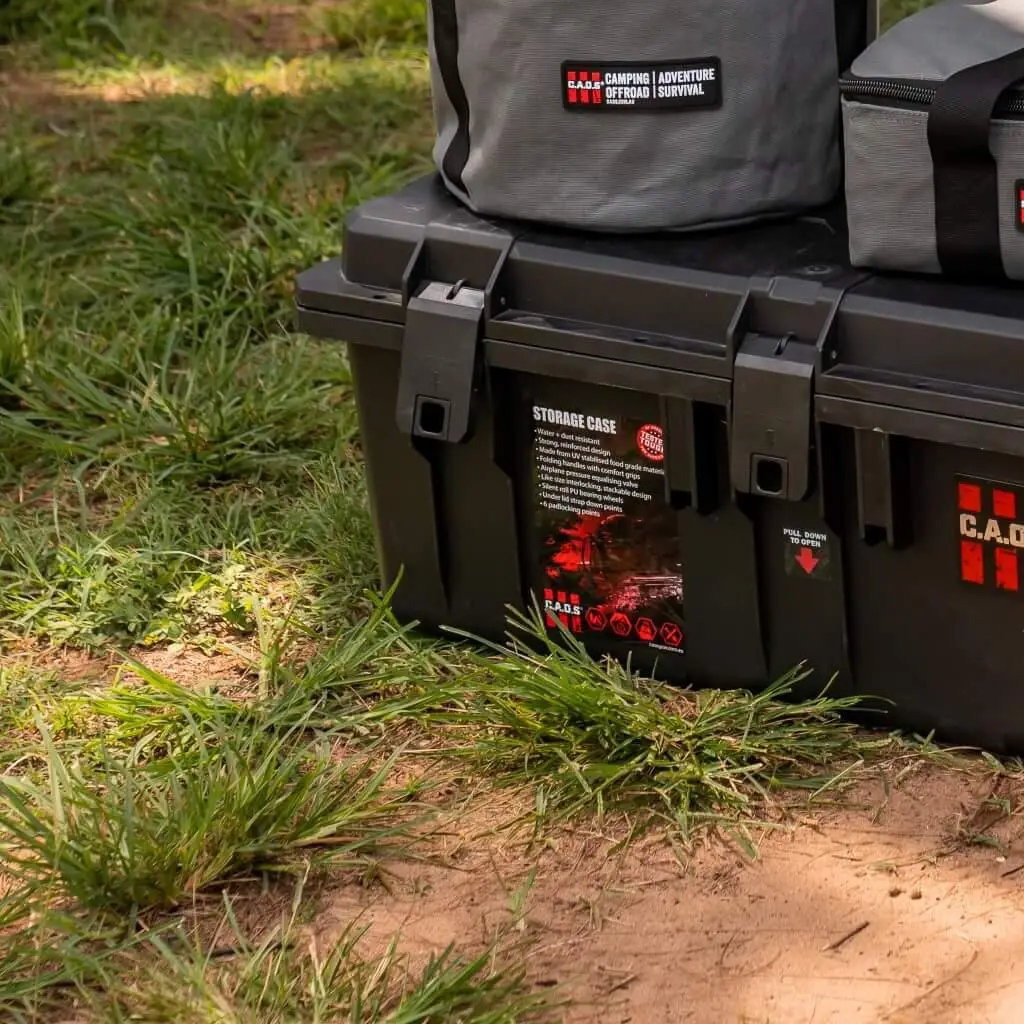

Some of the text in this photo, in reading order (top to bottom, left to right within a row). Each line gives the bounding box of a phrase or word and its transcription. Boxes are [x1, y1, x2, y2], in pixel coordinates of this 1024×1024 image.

[604, 68, 715, 85] CAMPING ADVENTURE
[605, 83, 704, 99] OFFROAD SURVIVAL
[532, 405, 586, 429] STORAGE
[586, 415, 617, 435] CASE
[537, 428, 555, 437] Water
[561, 432, 574, 441] dust
[575, 435, 600, 445] resistant
[640, 430, 664, 445] TESTE
[560, 442, 590, 452] reinforced
[591, 446, 611, 457] design
[539, 446, 555, 454] Made
[557, 449, 571, 457] from
[609, 459, 624, 467] food
[624, 462, 642, 472] grade
[540, 455, 562, 466] Folding
[562, 459, 586, 469] handles
[600, 468, 624, 477] comfort
[625, 471, 641, 480] grips
[540, 464, 638, 489] Airplane pressure equalising valve
[541, 482, 558, 491] Silent
[569, 487, 579, 495] PU
[603, 495, 624, 504] wheels
[603, 486, 631, 497] stackable
[631, 490, 652, 501] design
[542, 491, 561, 501] Under
[570, 497, 585, 507] strap
[585, 499, 603, 509] down
[603, 504, 623, 513] points
[548, 502, 581, 514] padlocking
[581, 508, 600, 517] points
[783, 528, 827, 541] PULL DOWN
[790, 536, 821, 547] TO OPEN
